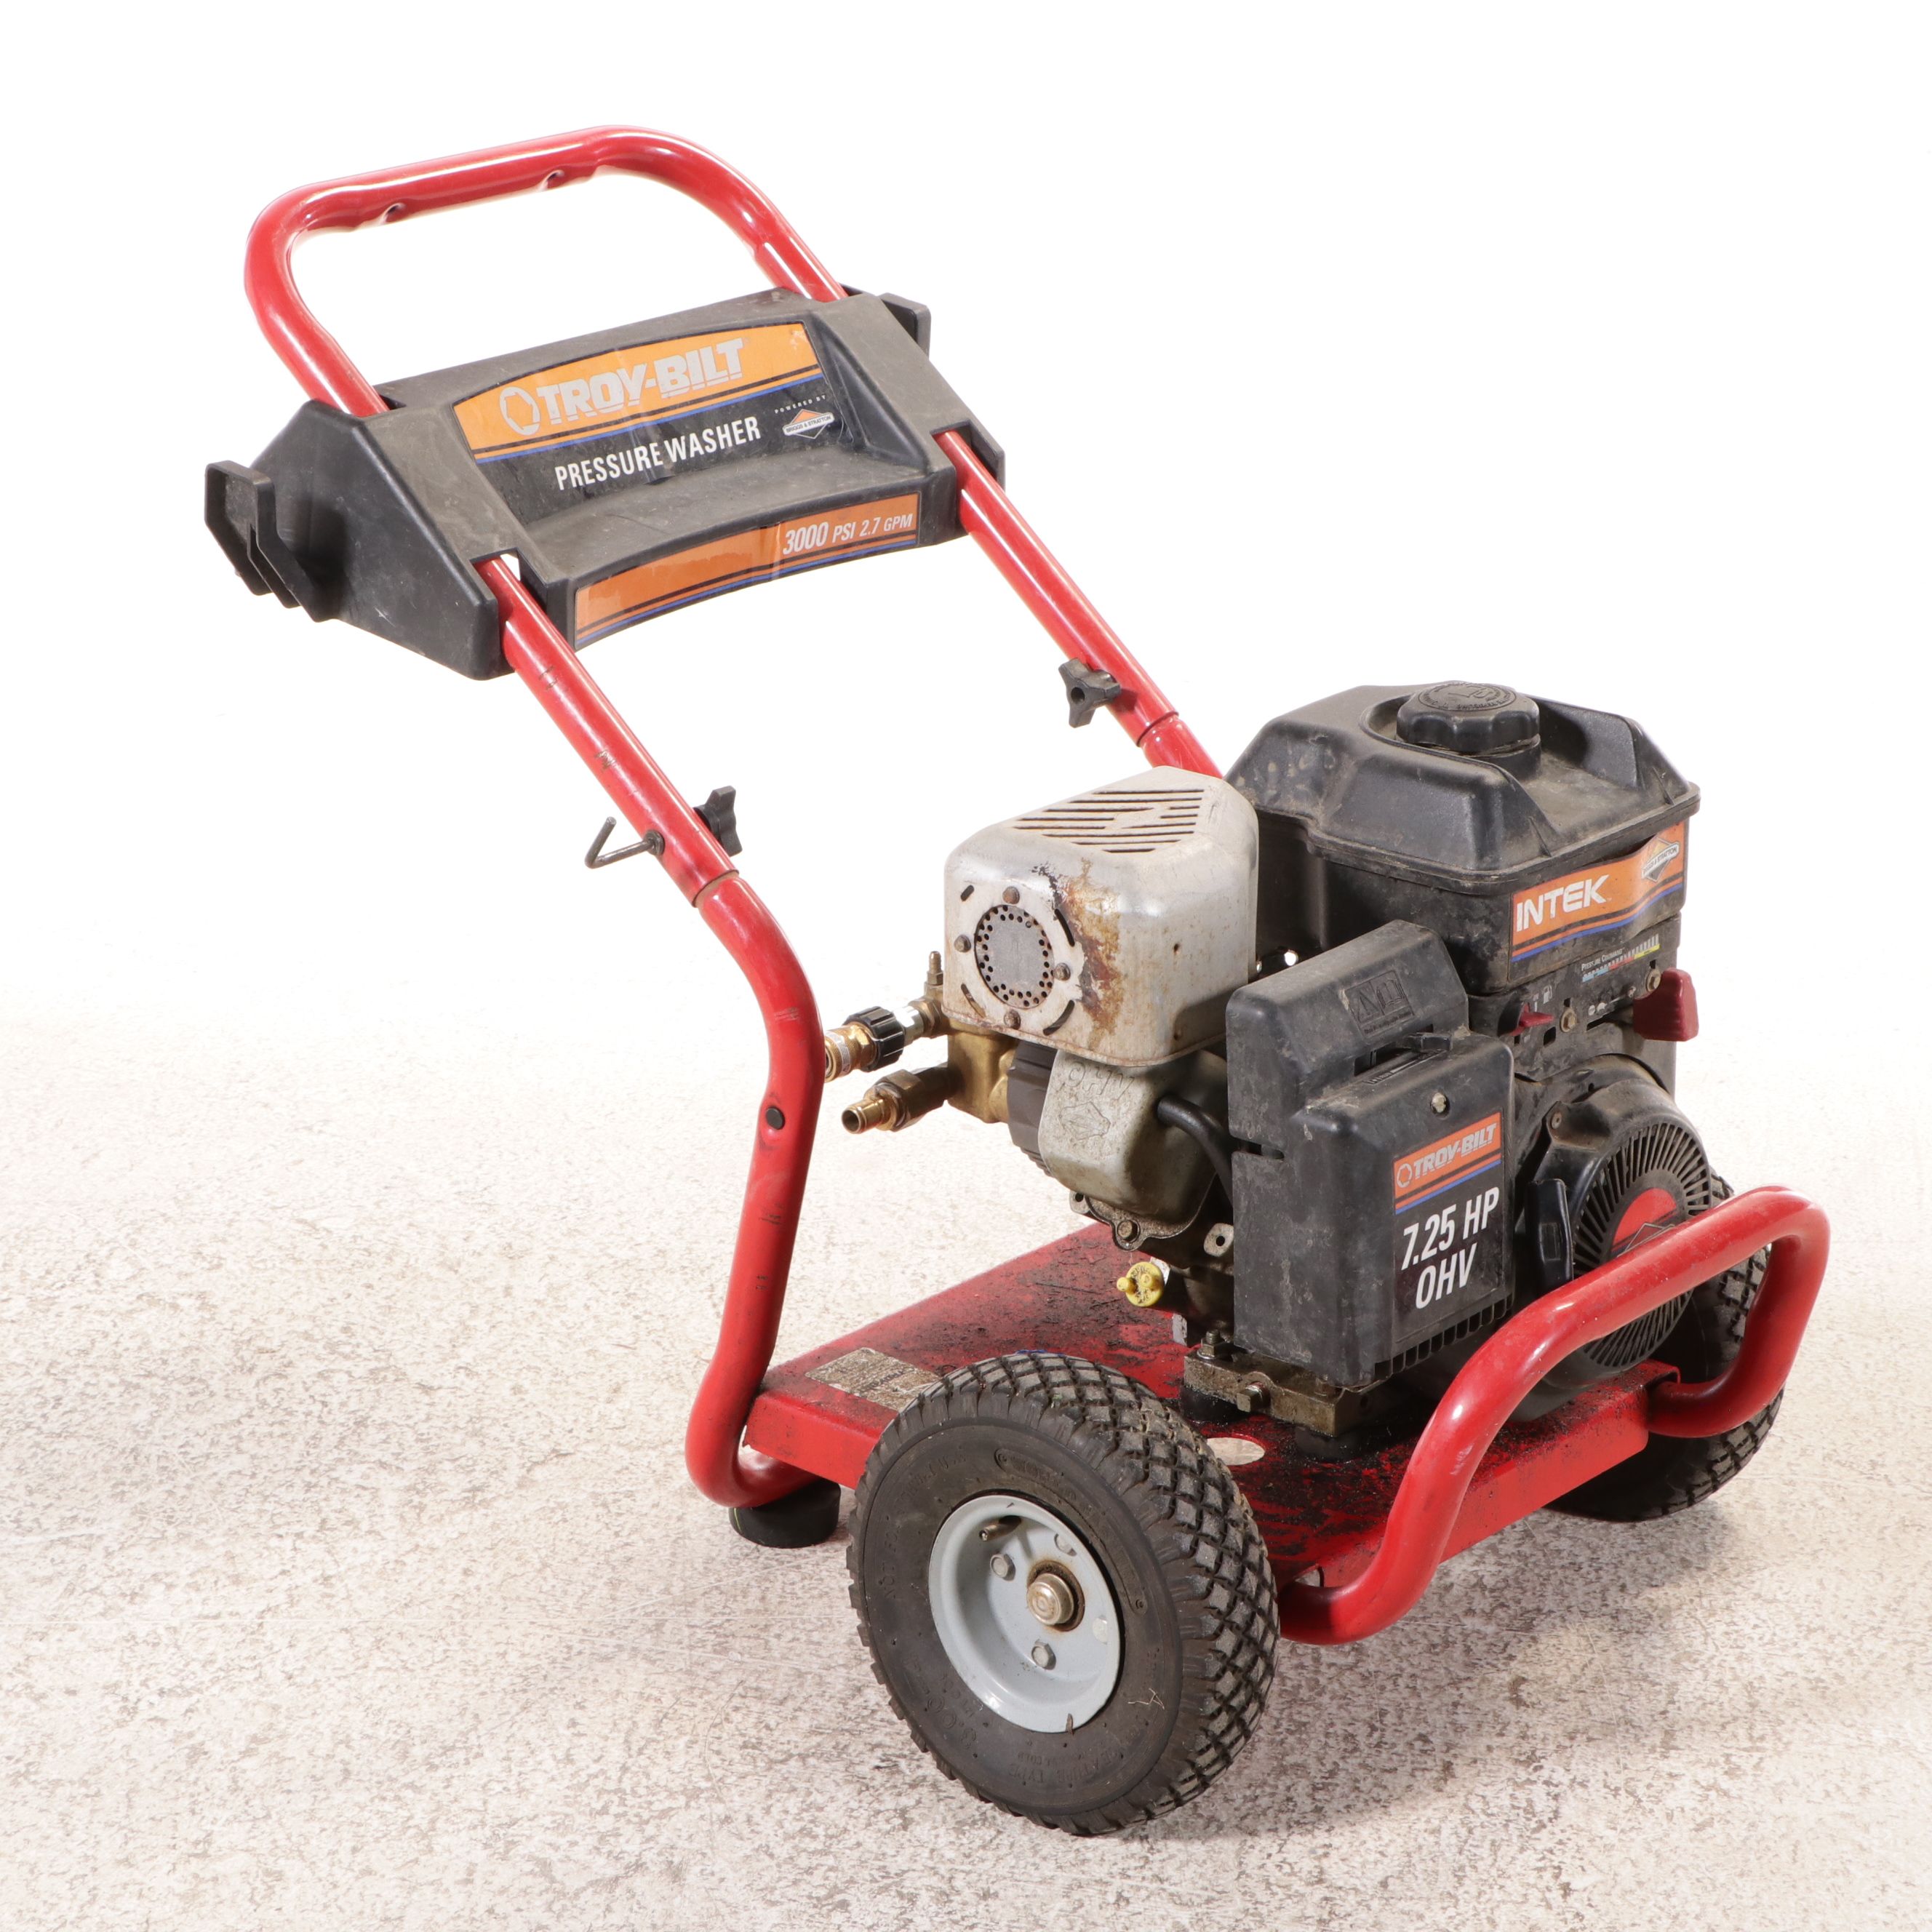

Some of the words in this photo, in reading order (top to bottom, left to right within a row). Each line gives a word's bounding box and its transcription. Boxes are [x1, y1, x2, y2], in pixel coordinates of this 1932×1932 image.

[536, 338, 743, 425] TROY-BILT
[775, 399, 813, 414] POWERED
[808, 415, 831, 426] STRATTON
[554, 442, 663, 490] PRESSURE
[663, 416, 761, 463] WASHER
[783, 522, 829, 555] 3000
[832, 522, 856, 543] PSI
[859, 516, 881, 537] 2.7
[884, 514, 913, 532] GPM
[1517, 874, 1609, 932] INTEK
[1413, 1123, 1496, 1179] TROY-BILT
[1401, 1204, 1456, 1271] 7.25
[1463, 1186, 1500, 1240] HP
[1416, 1242, 1477, 1309] OHV
